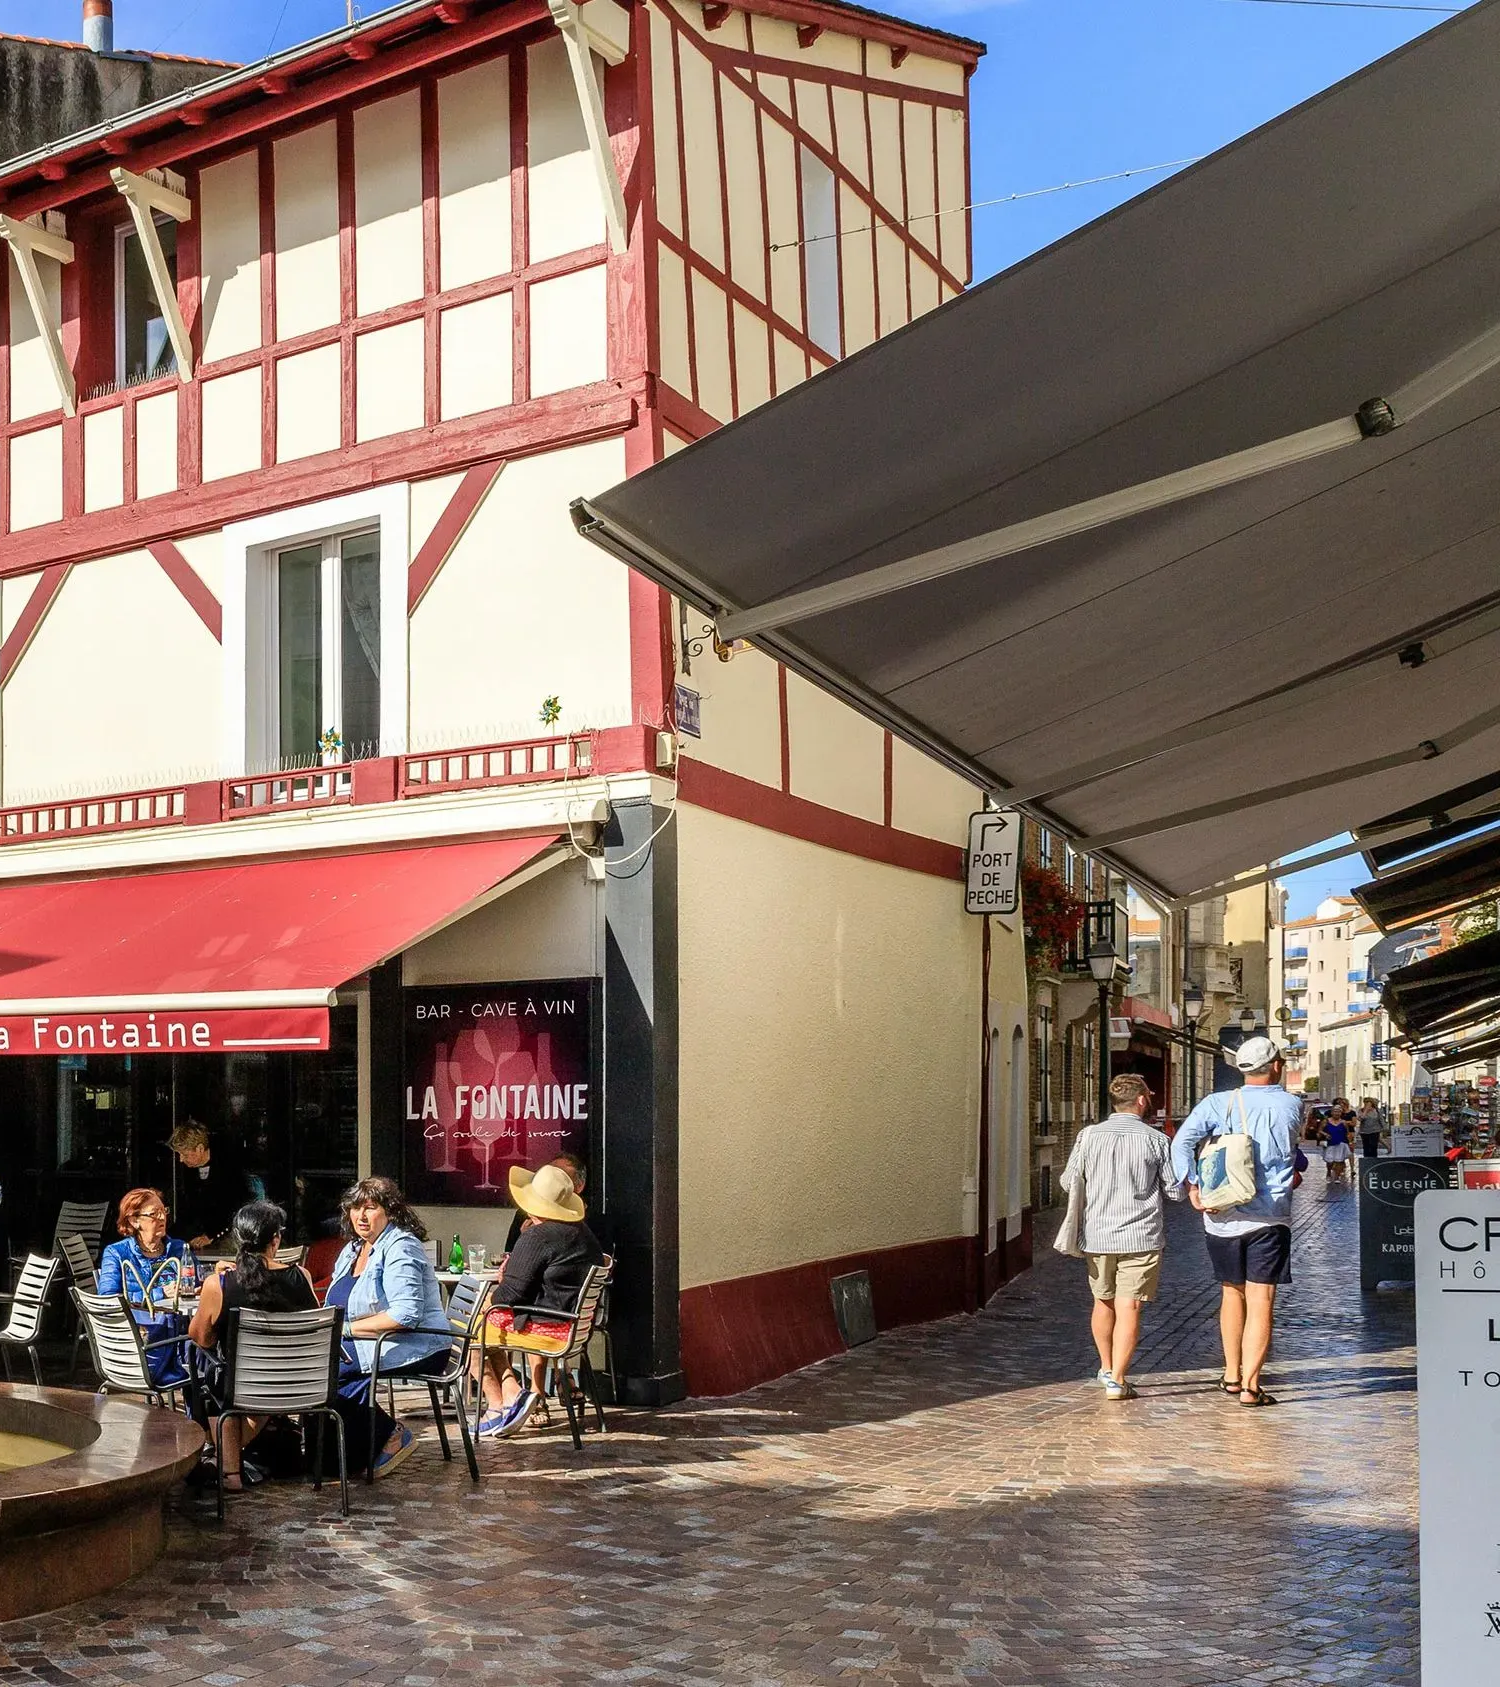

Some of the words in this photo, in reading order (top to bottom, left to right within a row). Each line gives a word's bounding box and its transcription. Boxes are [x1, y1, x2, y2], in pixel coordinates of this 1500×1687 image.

[972, 852, 1013, 868] PORT
[981, 872, 1001, 887] DE
[968, 889, 1013, 905] PECHE
[416, 1004, 450, 1020] BAR
[470, 1001, 518, 1018] CAVE
[524, 997, 537, 1016] À
[543, 999, 576, 1015] VIN
[32, 1013, 211, 1049] Fontaine
[406, 1085, 439, 1120] LA
[455, 1083, 588, 1120] FONTAINE
[452, 1125, 494, 1137] coule
[500, 1126, 521, 1137] de
[527, 1128, 572, 1138] source
